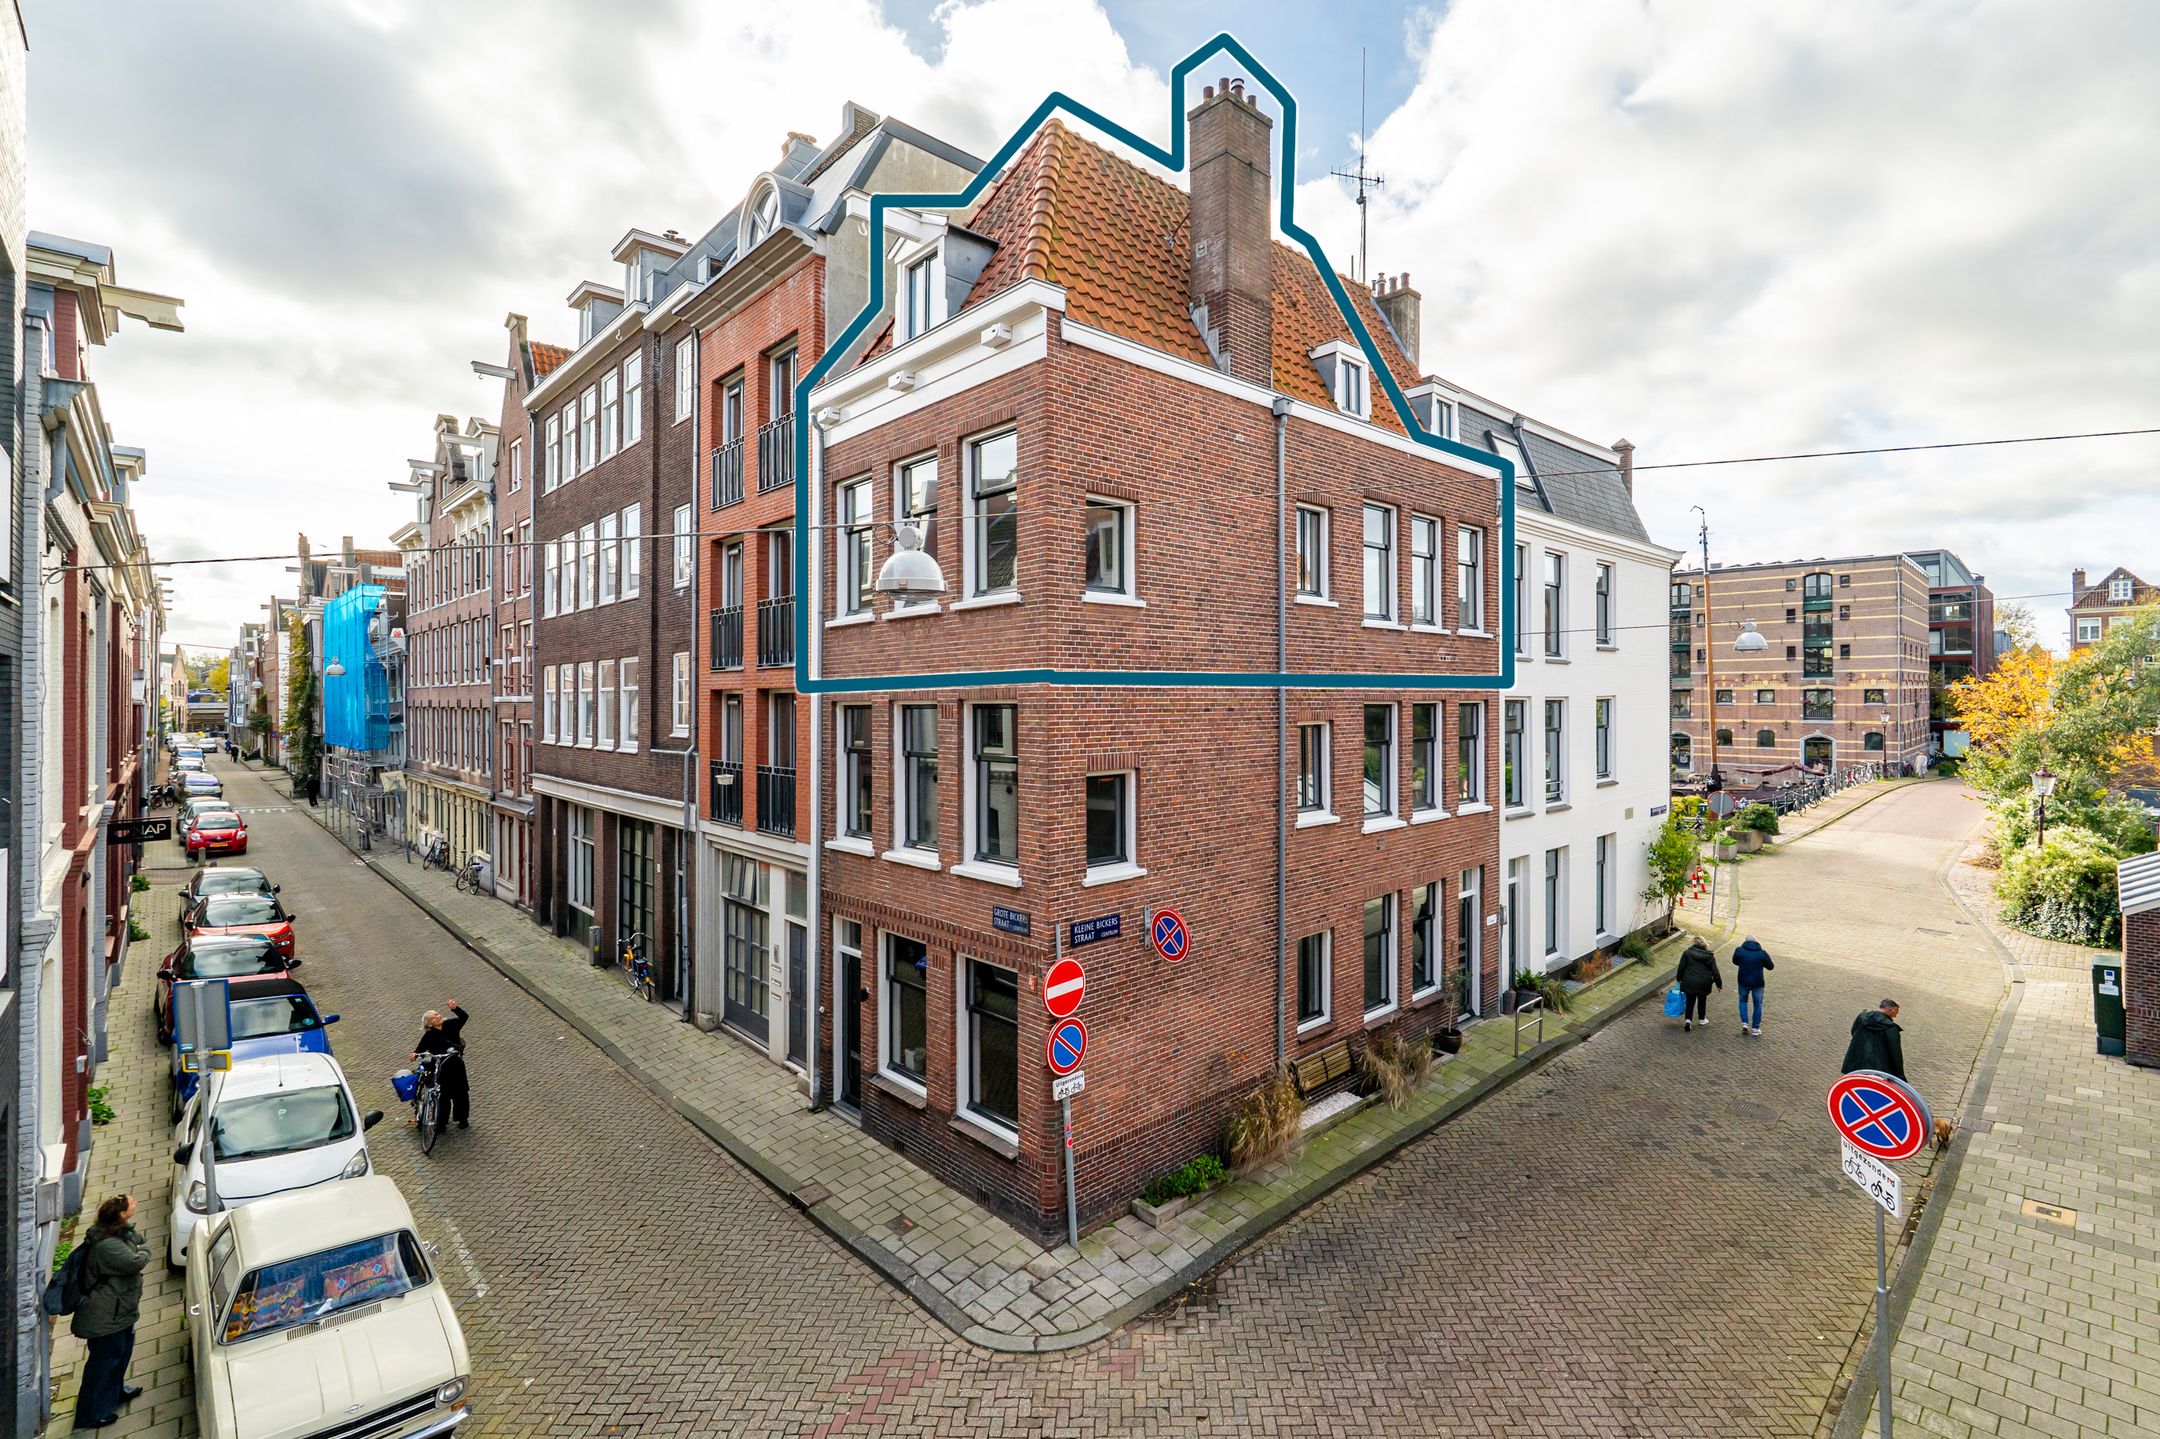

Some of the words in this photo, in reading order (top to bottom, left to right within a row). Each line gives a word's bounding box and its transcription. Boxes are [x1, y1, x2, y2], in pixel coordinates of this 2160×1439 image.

[993, 908, 1009, 919] GROTE
[1010, 911, 1029, 924] BICKERS
[993, 917, 1010, 928] STRAAT
[1074, 922, 1095, 934] KLEINE
[1096, 917, 1118, 930] BICKERS
[1074, 931, 1095, 944] STRAAT
[1843, 1141, 1896, 1188] uitgezonderd
